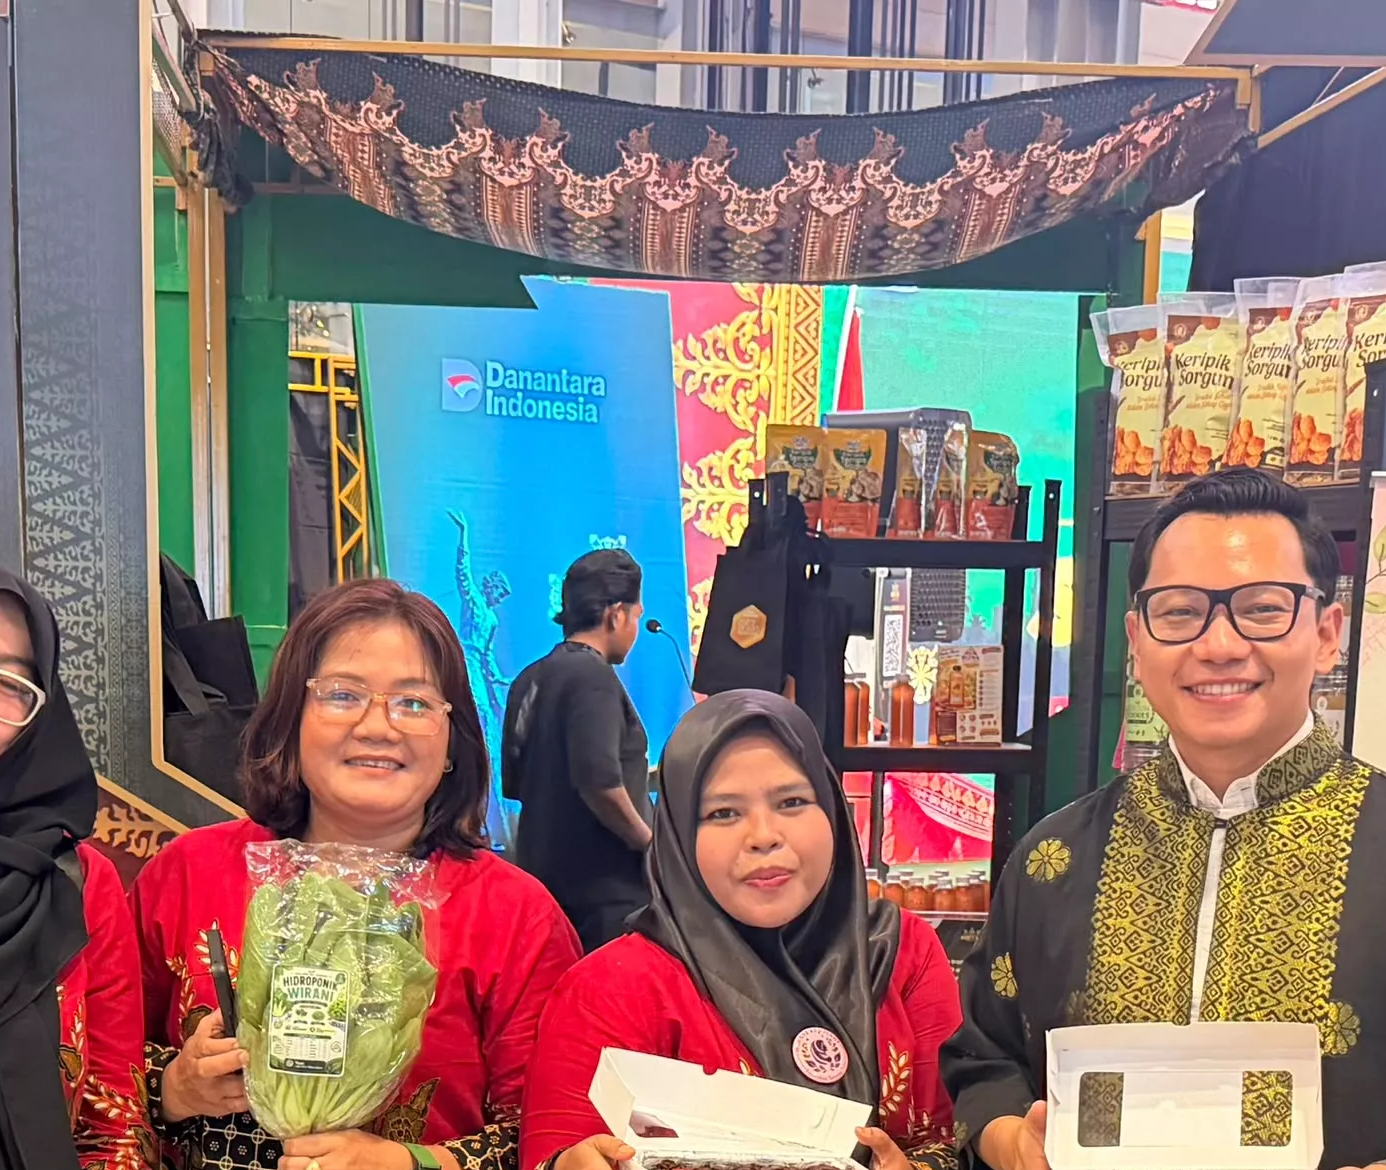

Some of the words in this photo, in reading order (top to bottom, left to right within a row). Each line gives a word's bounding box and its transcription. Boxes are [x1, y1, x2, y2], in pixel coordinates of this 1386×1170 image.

[1174, 352, 1231, 372] Keripik
[485, 360, 606, 396] Danantara
[485, 389, 599, 423] Indonesia
[282, 975, 338, 991] HIDROPONIK
[287, 986, 334, 1002] WIRANI
